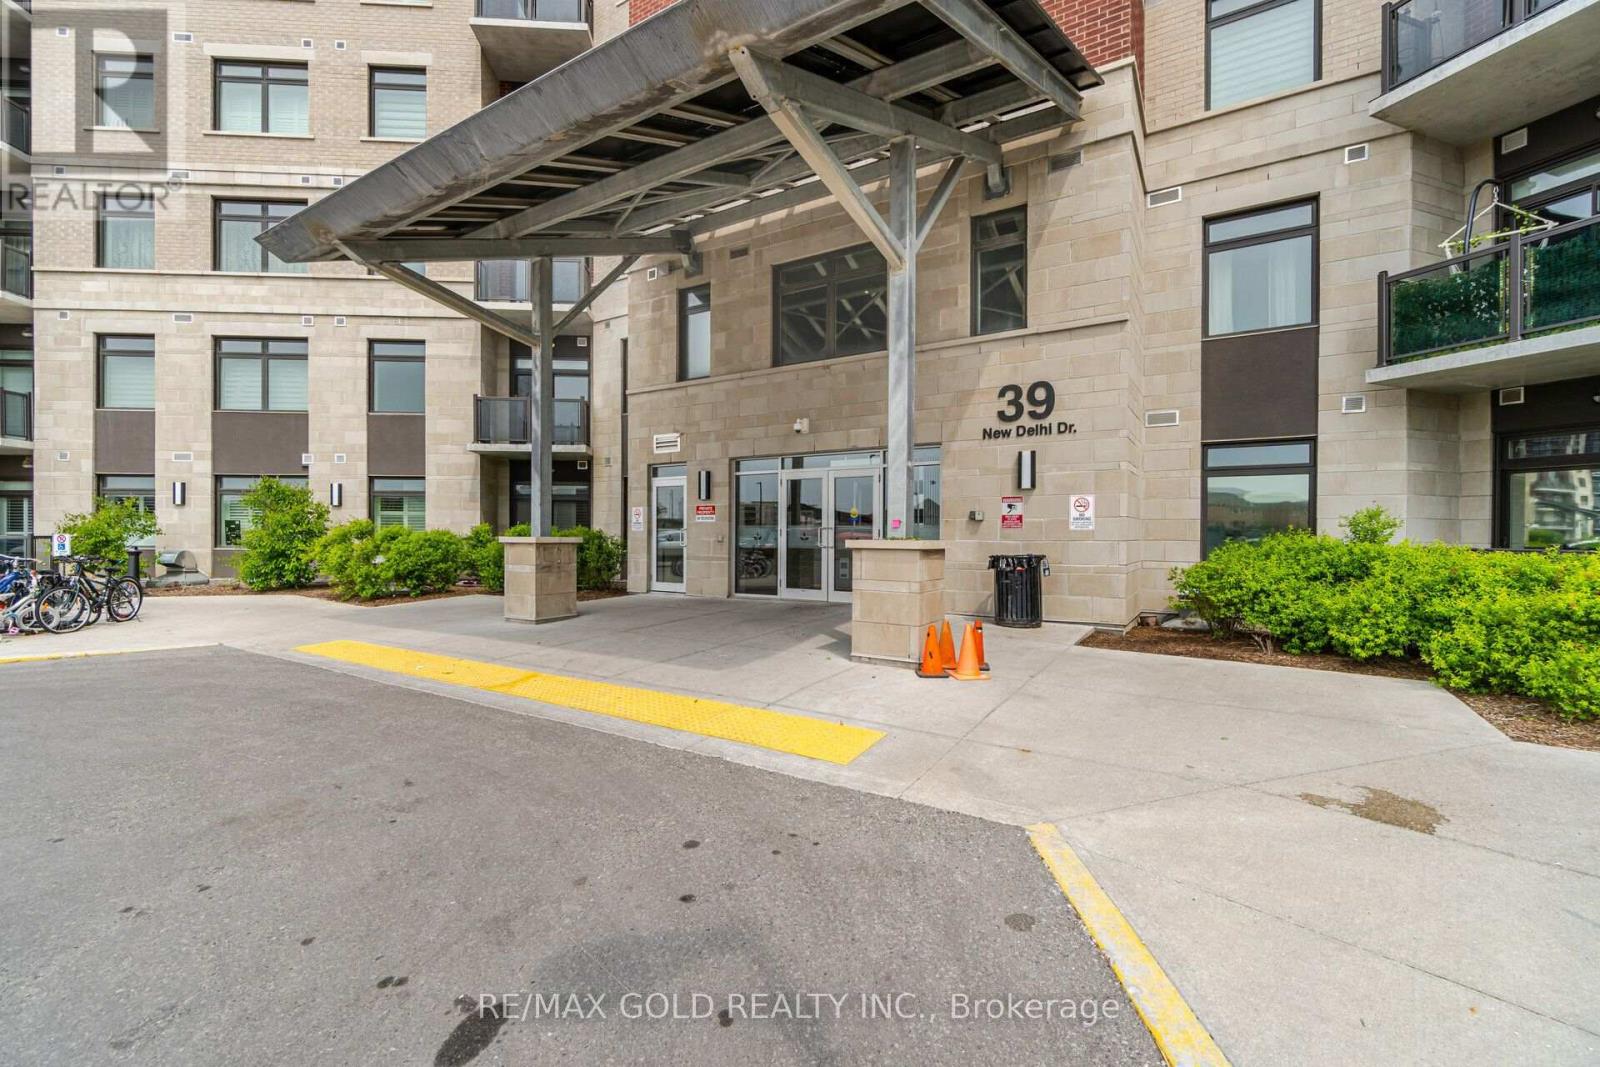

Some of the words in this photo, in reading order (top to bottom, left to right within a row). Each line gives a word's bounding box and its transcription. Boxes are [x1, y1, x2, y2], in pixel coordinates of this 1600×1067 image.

[997, 381, 1055, 422] 39
[982, 428, 1012, 440] New
[1016, 423, 1052, 437] Delhi
[1057, 422, 1077, 434] Dr.
